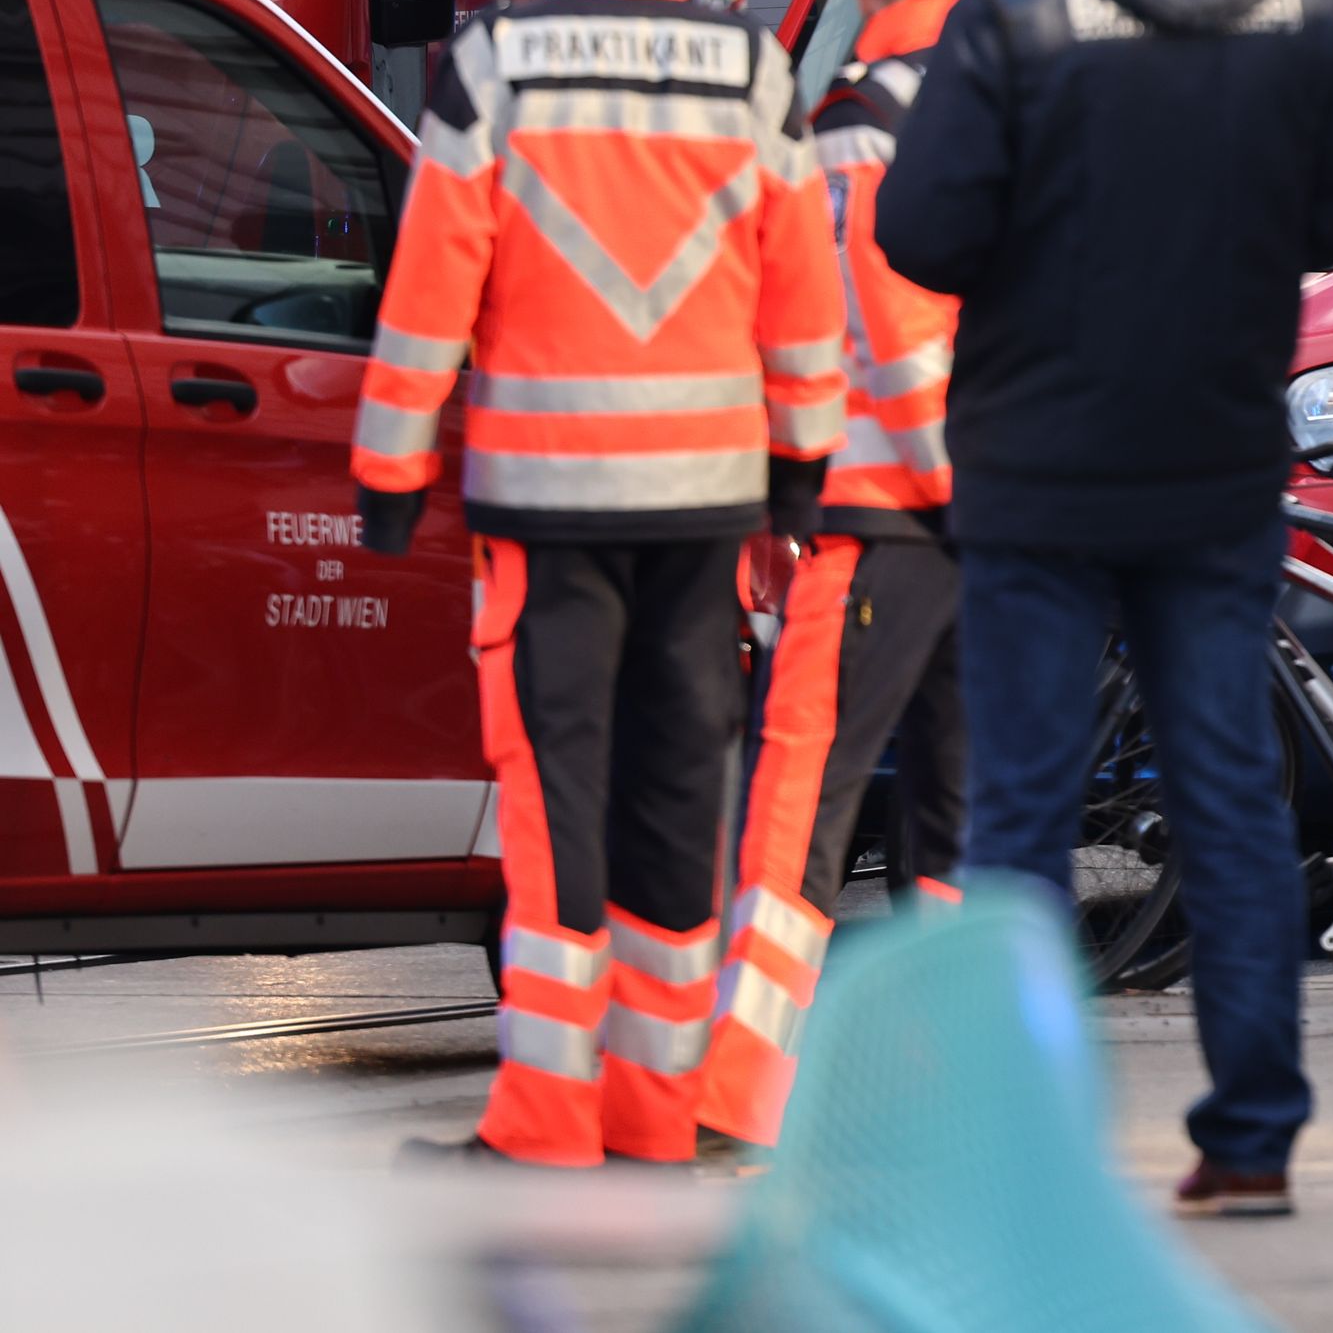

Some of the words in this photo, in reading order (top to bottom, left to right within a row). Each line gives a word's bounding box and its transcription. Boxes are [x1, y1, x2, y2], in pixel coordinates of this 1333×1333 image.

[521, 27, 724, 66] PRAKTIKANT
[266, 511, 364, 547] FEUERWE
[316, 559, 345, 581] DER
[265, 593, 335, 628] STADT
[336, 596, 389, 630] WIEN
